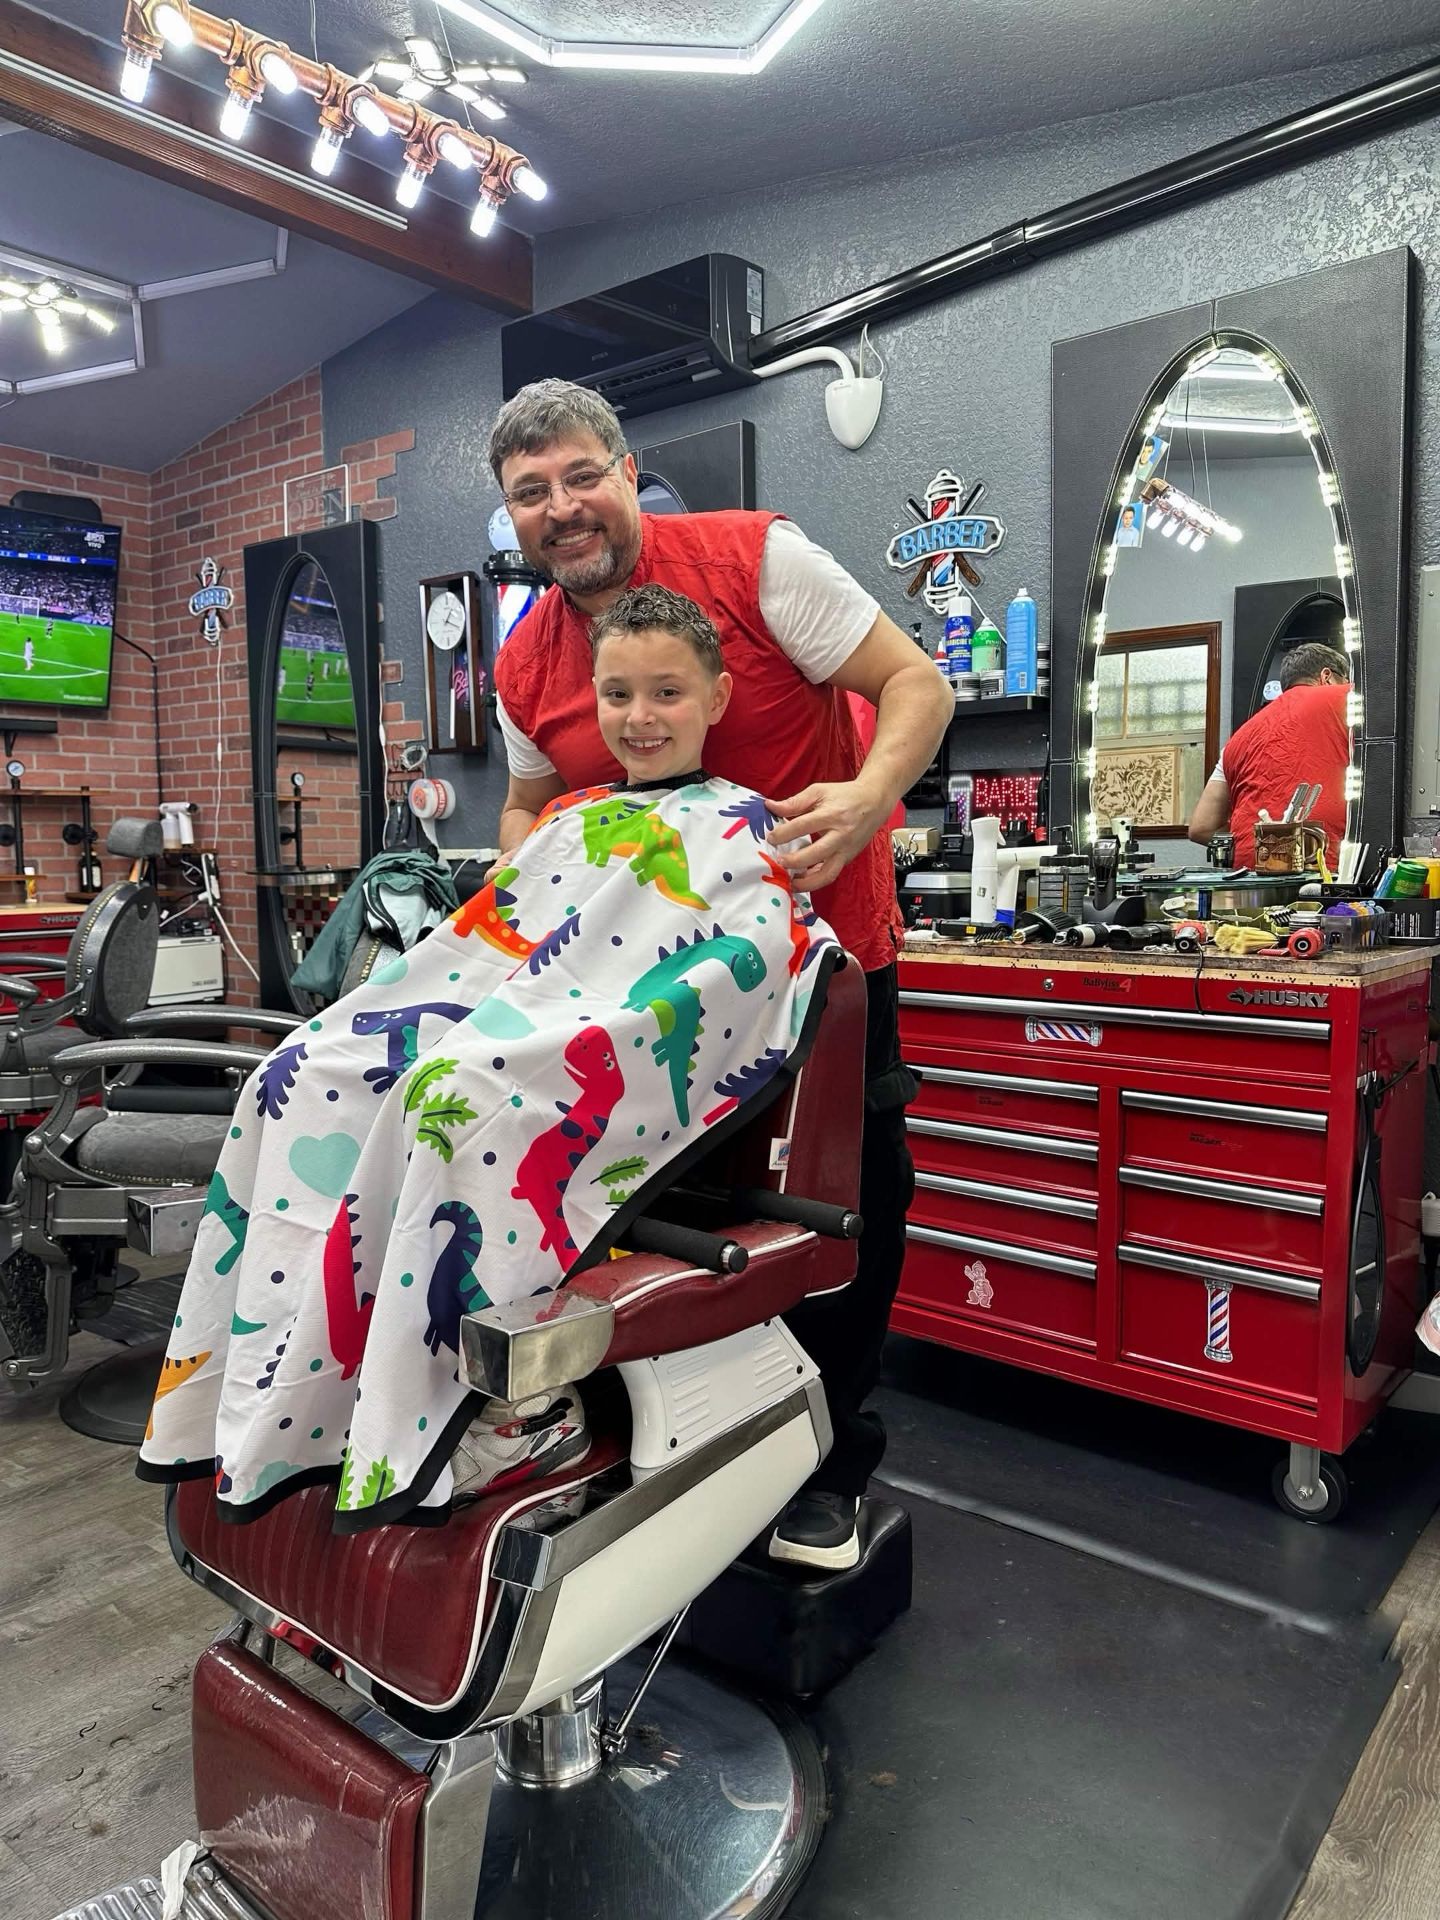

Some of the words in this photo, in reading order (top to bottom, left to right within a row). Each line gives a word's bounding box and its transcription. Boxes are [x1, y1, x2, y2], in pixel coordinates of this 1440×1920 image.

[288, 488, 345, 519] OPEN
[900, 520, 988, 561] BARBER
[975, 777, 1042, 807] BARBE
[1253, 989, 1329, 1008] HUSKY
